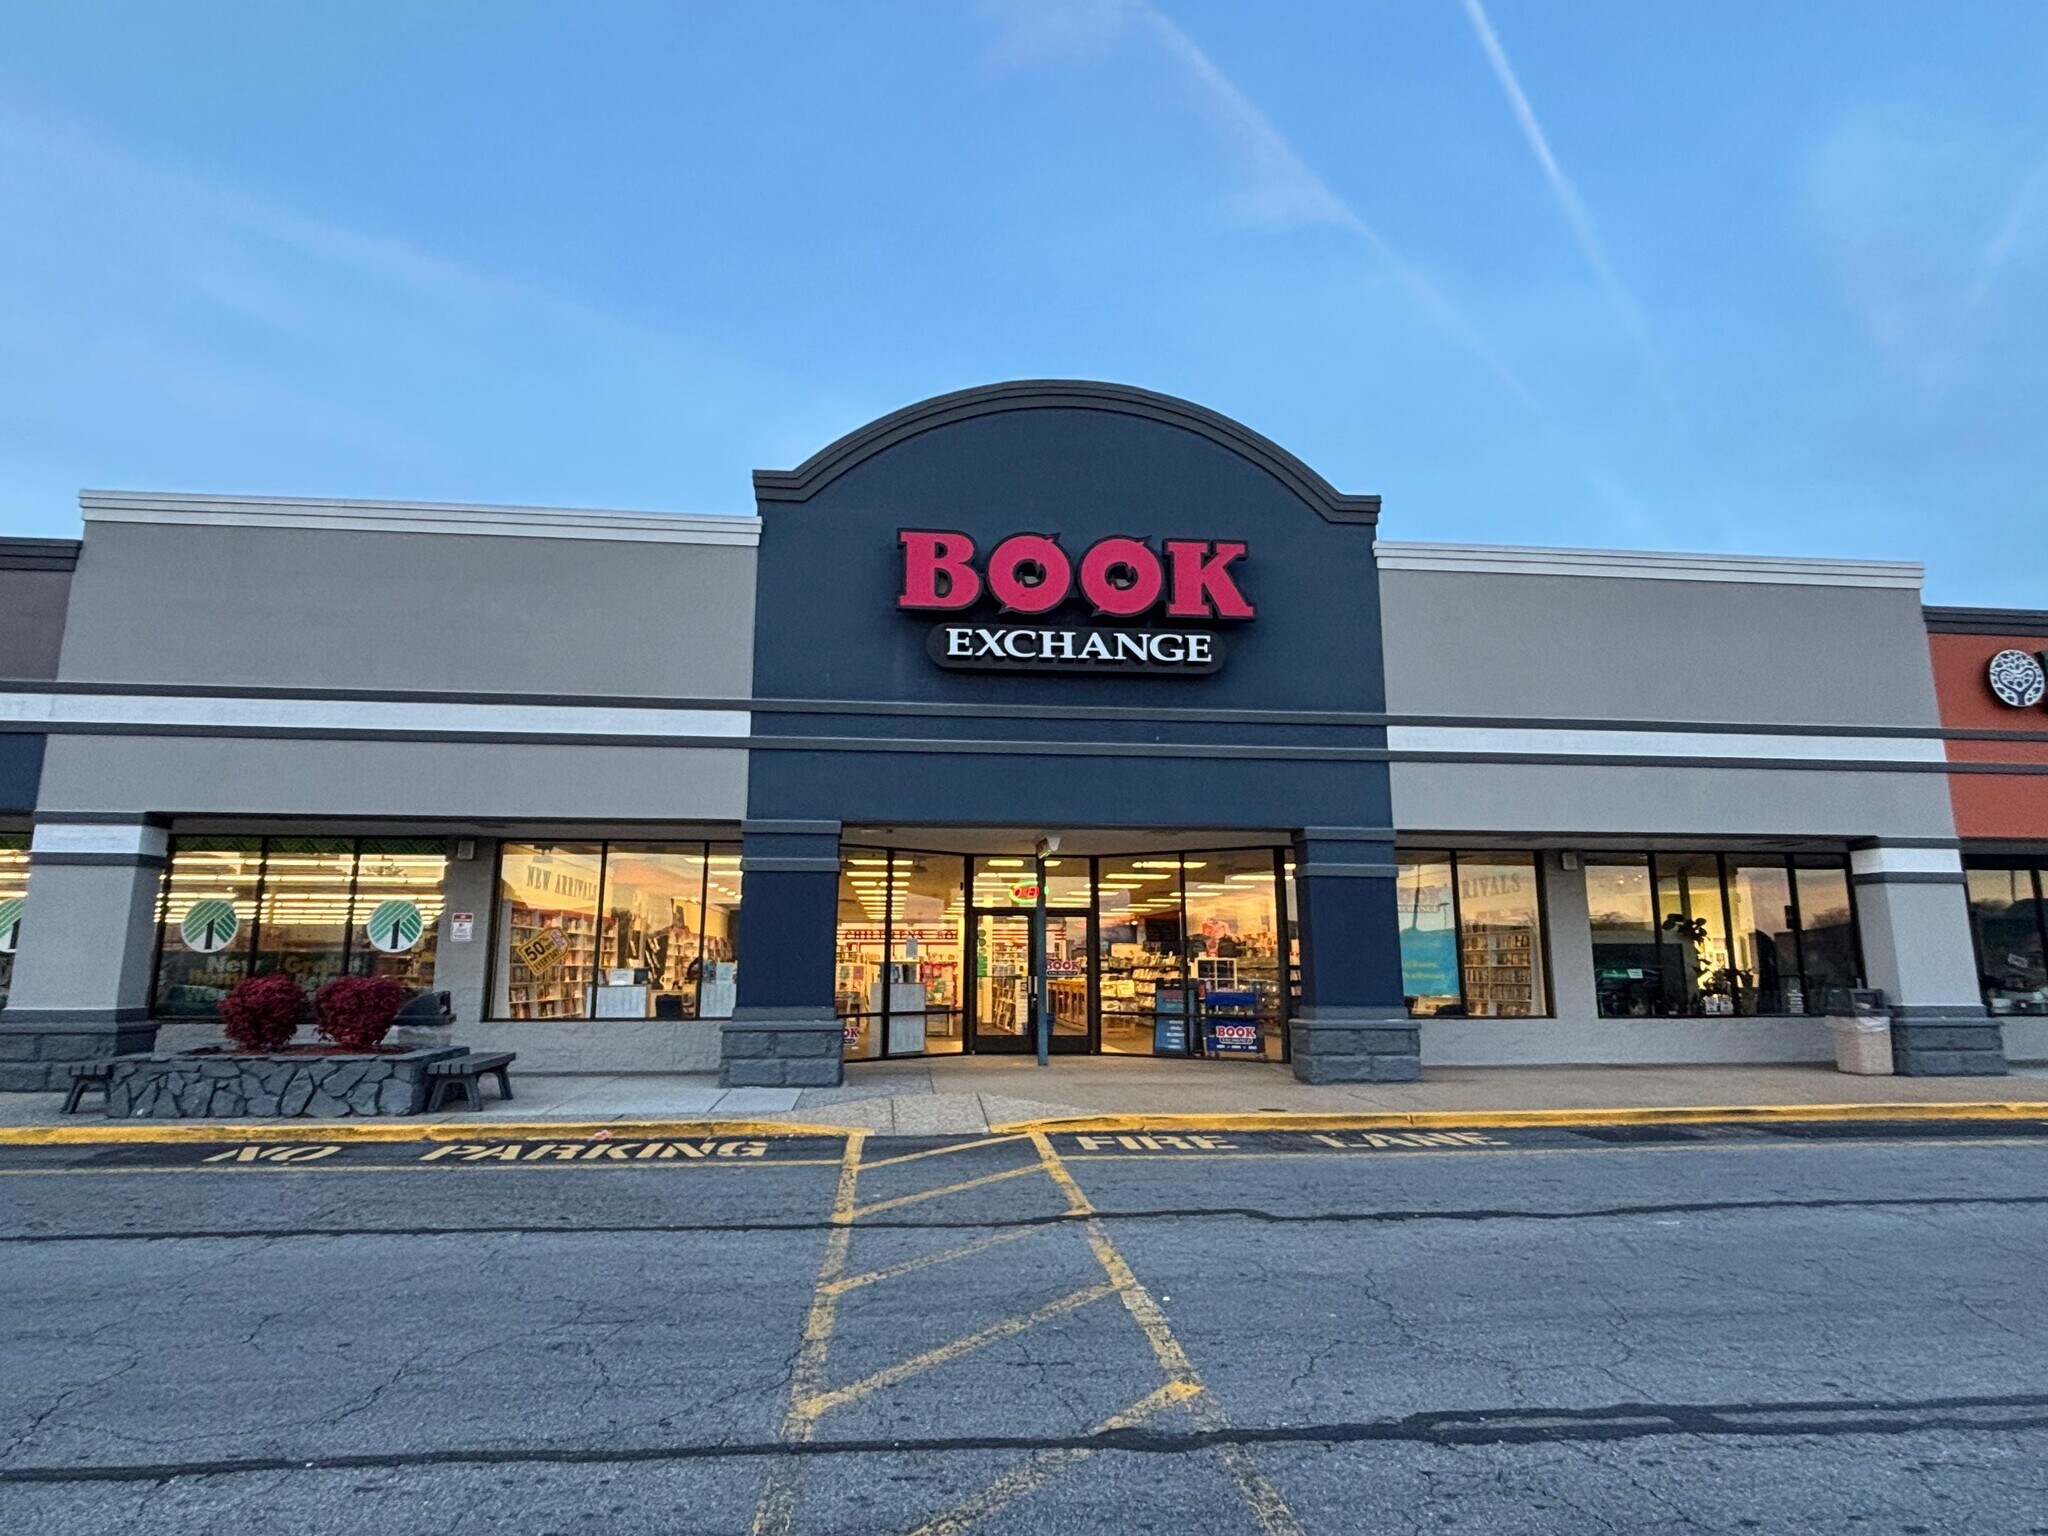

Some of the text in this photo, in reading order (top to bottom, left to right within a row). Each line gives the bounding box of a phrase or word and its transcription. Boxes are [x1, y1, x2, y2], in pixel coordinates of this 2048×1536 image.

[898, 529, 1255, 620] BOOK
[945, 627, 1212, 663] EXCHANGE
[526, 865, 598, 901] NEW ARRIVALS
[1216, 1026, 1256, 1038] BOOK
[202, 1141, 768, 1163] NO PARKING
[1075, 1131, 1509, 1150] FIRE LANE
